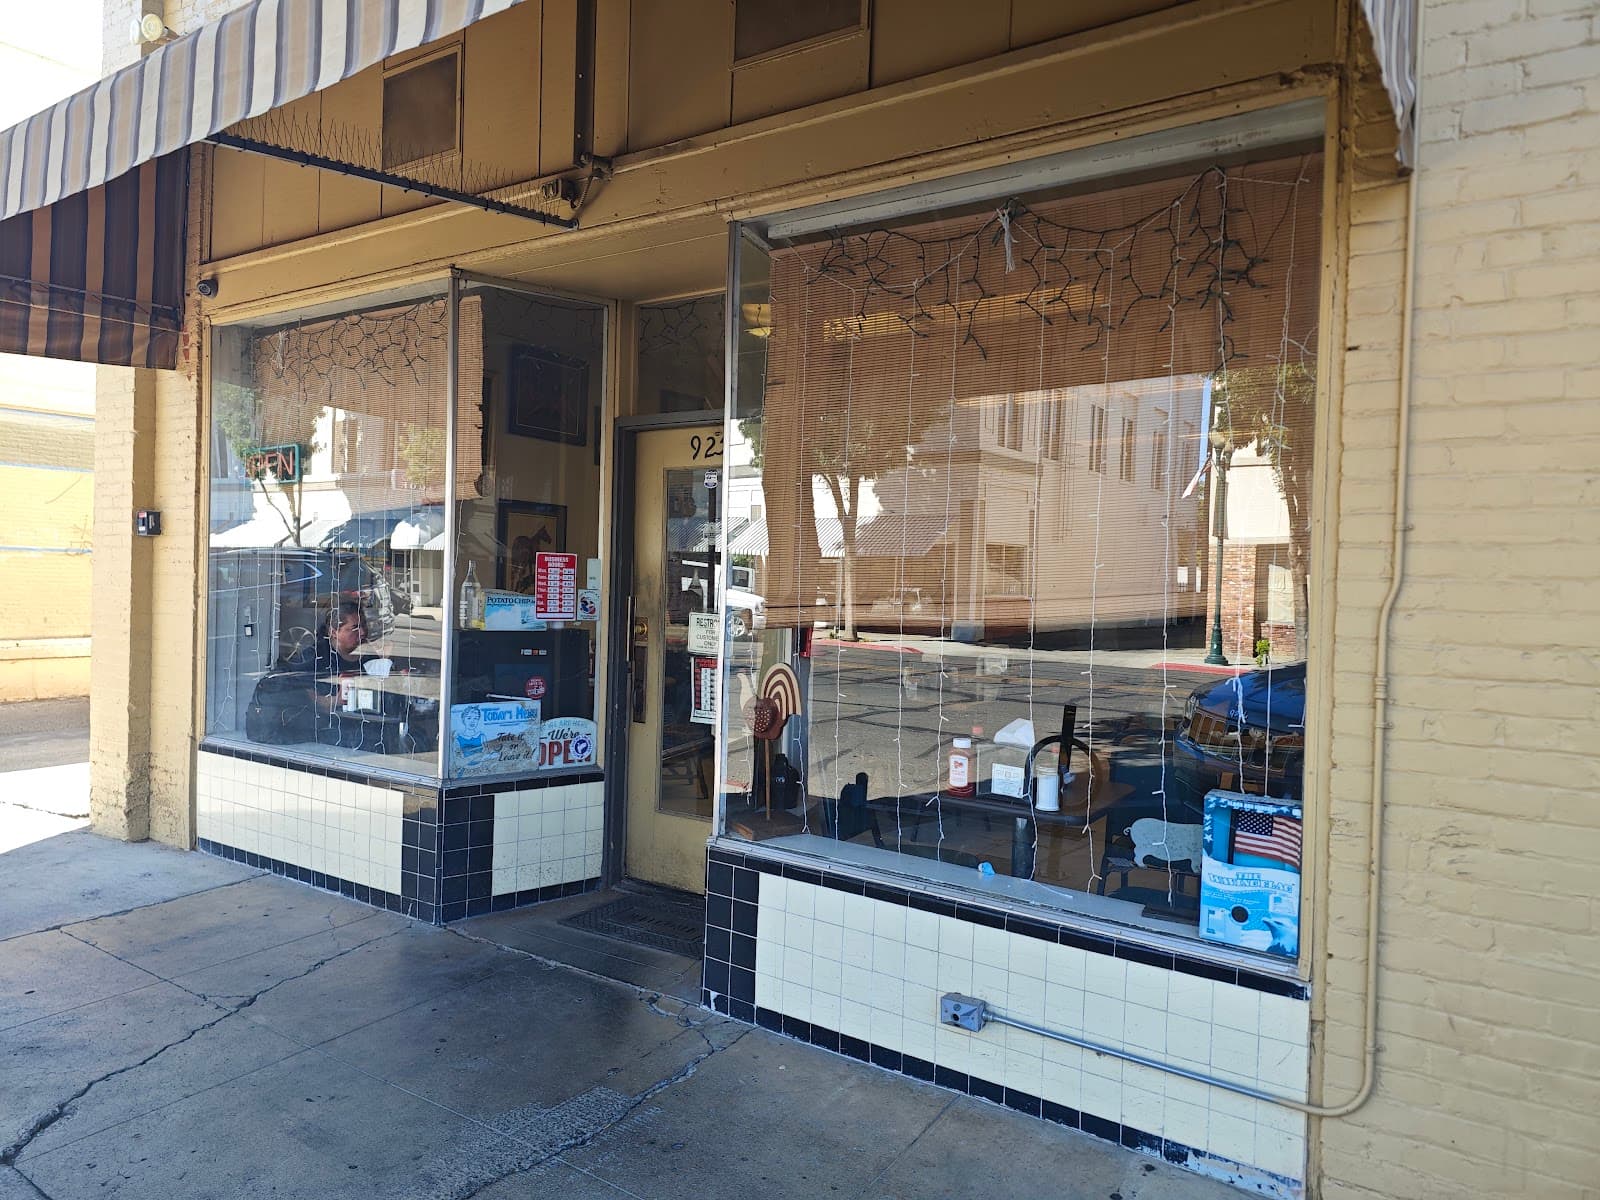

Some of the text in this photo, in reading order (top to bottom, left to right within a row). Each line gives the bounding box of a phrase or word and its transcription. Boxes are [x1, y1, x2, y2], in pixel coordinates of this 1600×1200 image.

[487, 596, 514, 604] POTATO
[547, 727, 580, 741] We're
[539, 740, 591, 767] PE
[1235, 871, 1262, 880] THE
[1208, 873, 1260, 888] WAVING
[1260, 880, 1294, 893] FLAG
